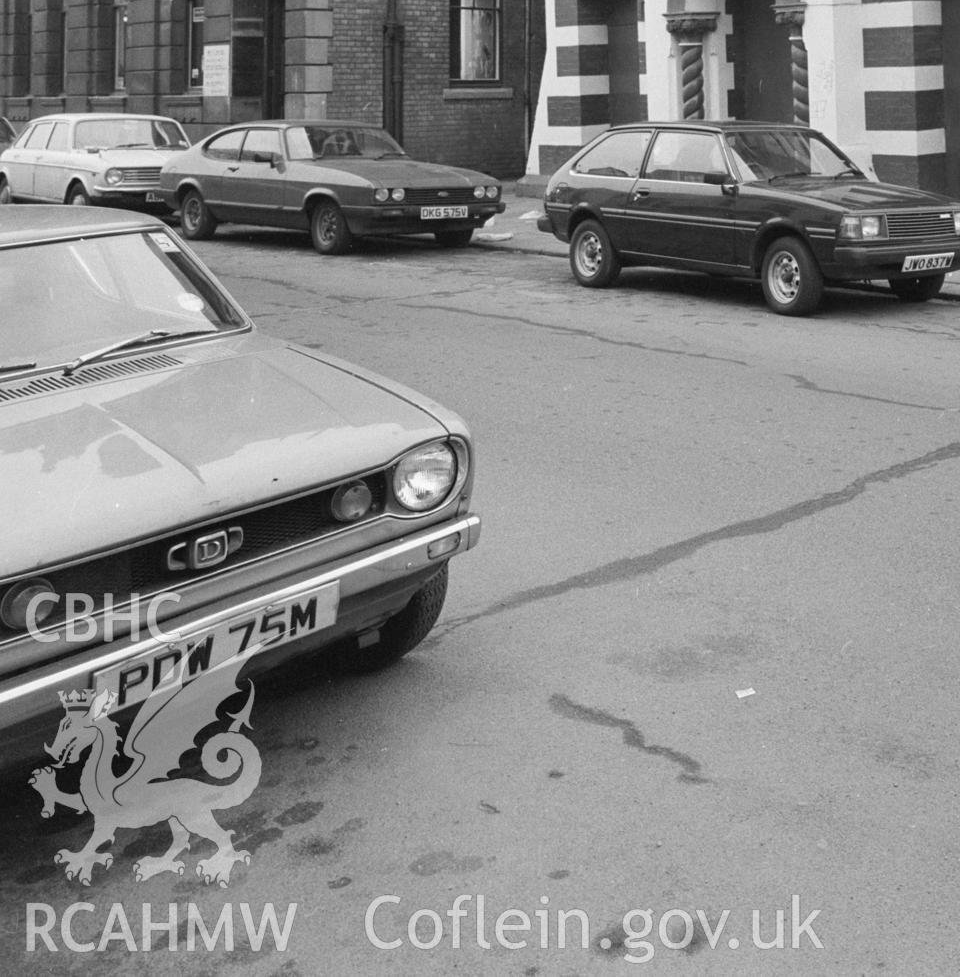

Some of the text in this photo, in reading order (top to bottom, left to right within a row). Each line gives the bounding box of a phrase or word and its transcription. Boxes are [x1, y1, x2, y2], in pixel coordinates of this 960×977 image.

[422, 207, 467, 218] DKG 575V
[926, 255, 953, 269] 837W
[200, 541, 222, 562] D
[118, 596, 318, 707] PDW 75M
